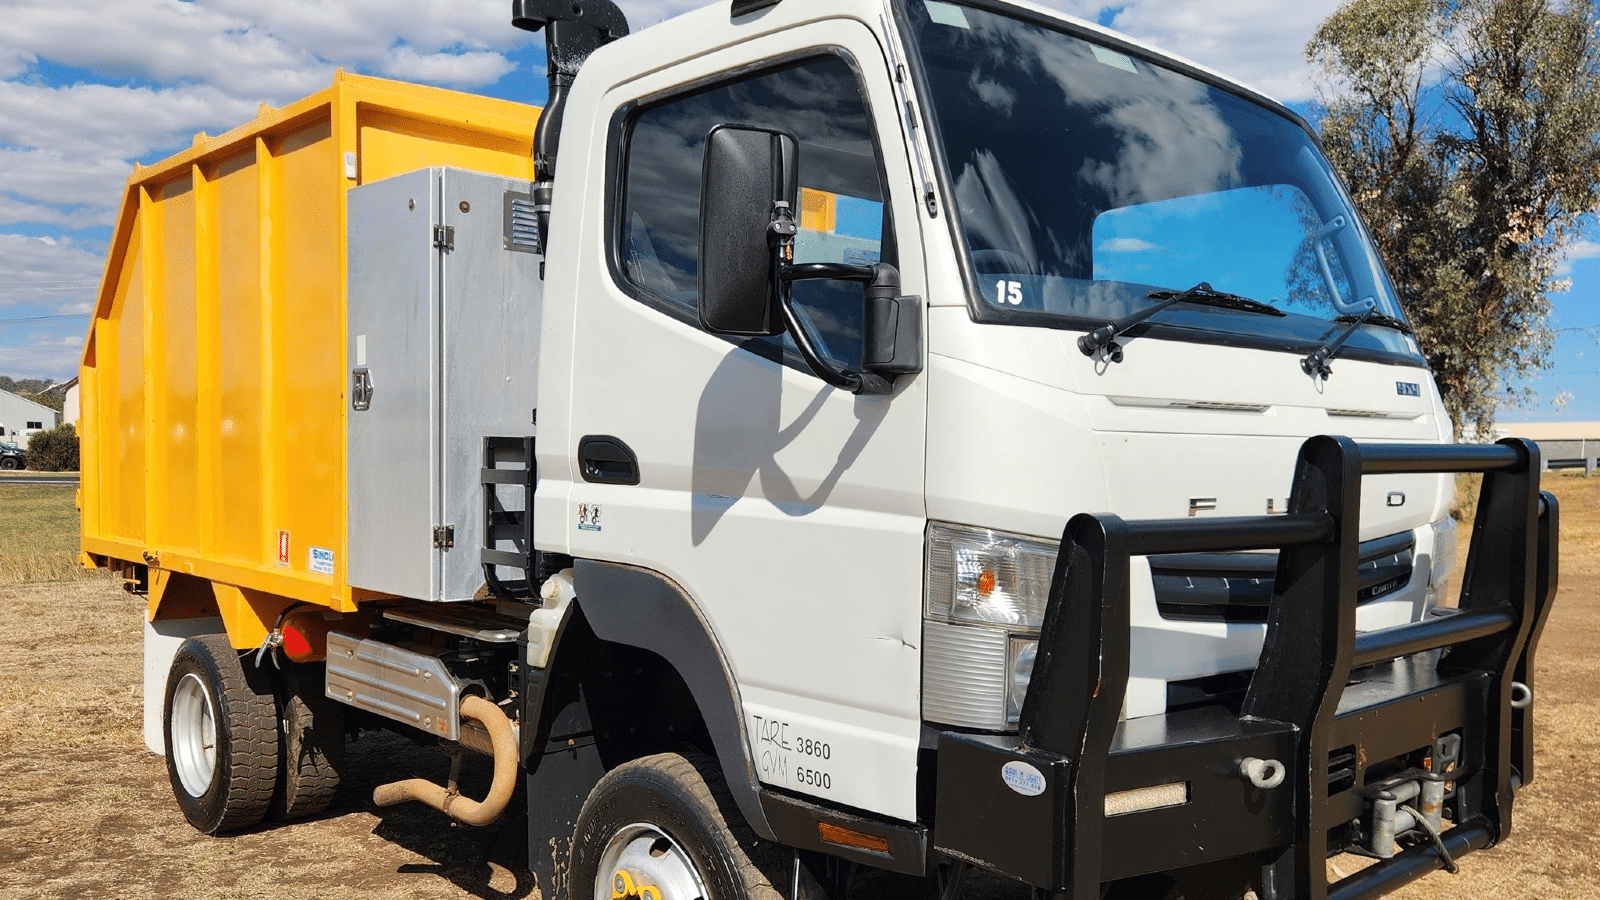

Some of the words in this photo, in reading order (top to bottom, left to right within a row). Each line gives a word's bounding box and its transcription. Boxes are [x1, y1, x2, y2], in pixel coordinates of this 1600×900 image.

[996, 280, 1023, 305] 15
[753, 715, 792, 751] TARE
[796, 737, 831, 760] 3860
[761, 748, 788, 784] GVM
[796, 766, 831, 789] 6500
